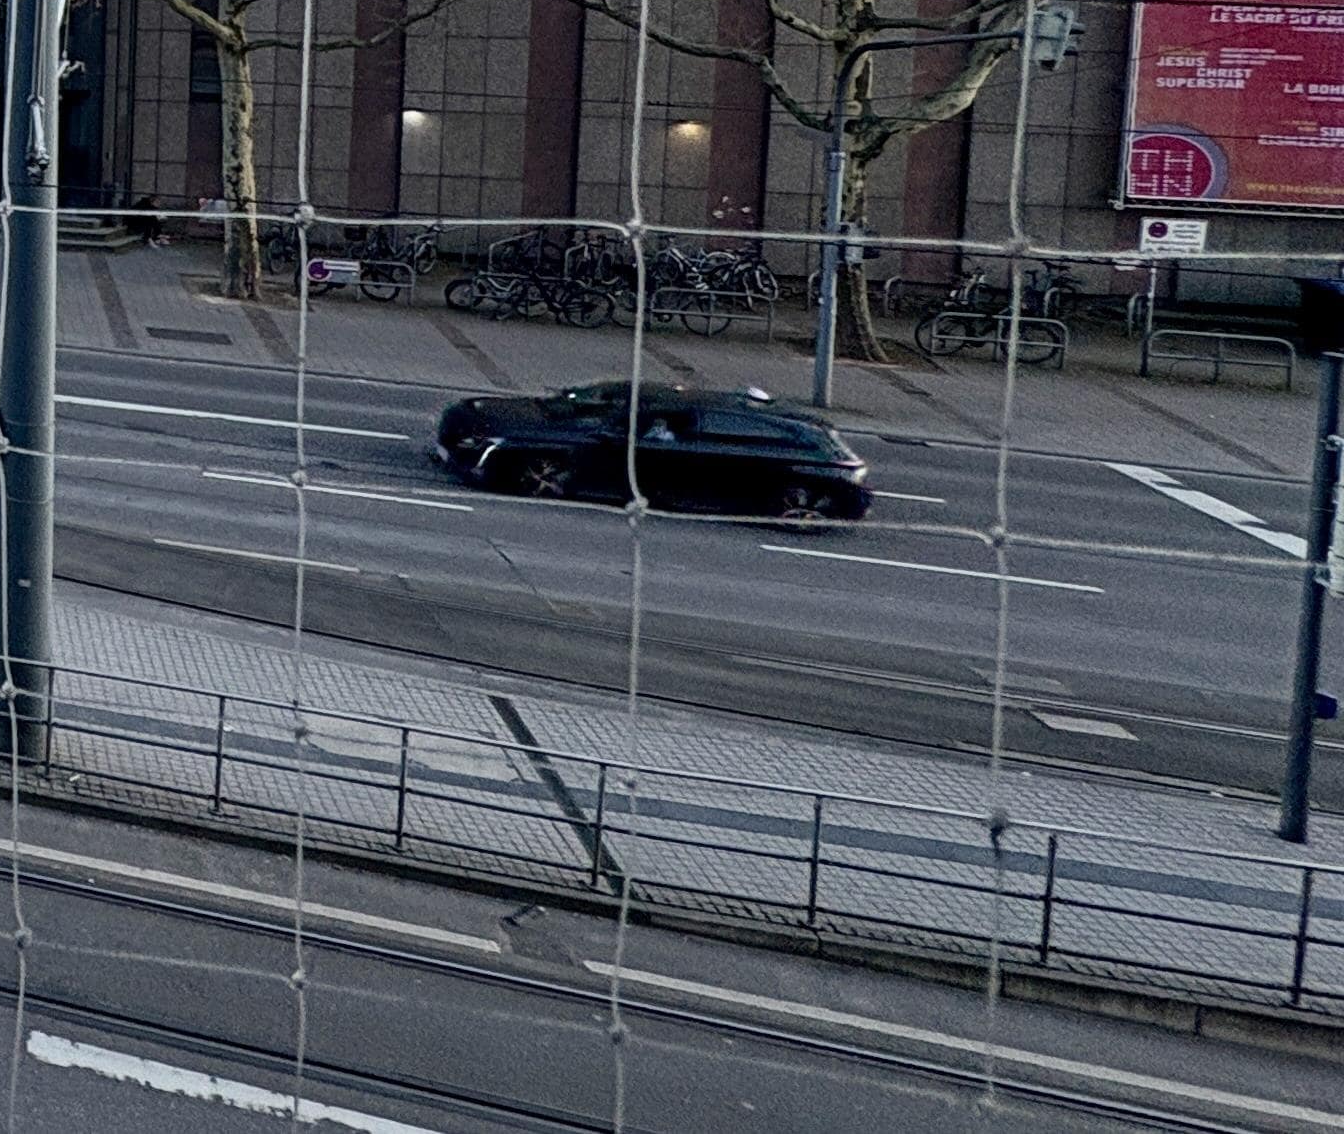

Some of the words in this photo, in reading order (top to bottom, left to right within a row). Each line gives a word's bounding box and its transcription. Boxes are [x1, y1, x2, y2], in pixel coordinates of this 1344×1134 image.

[1209, 12, 1230, 23] LE
[1156, 56, 1206, 67] JESUS
[1196, 68, 1253, 79] CHRIST
[1156, 77, 1246, 89] SUPERSTAR
[1283, 83, 1304, 94] LA
